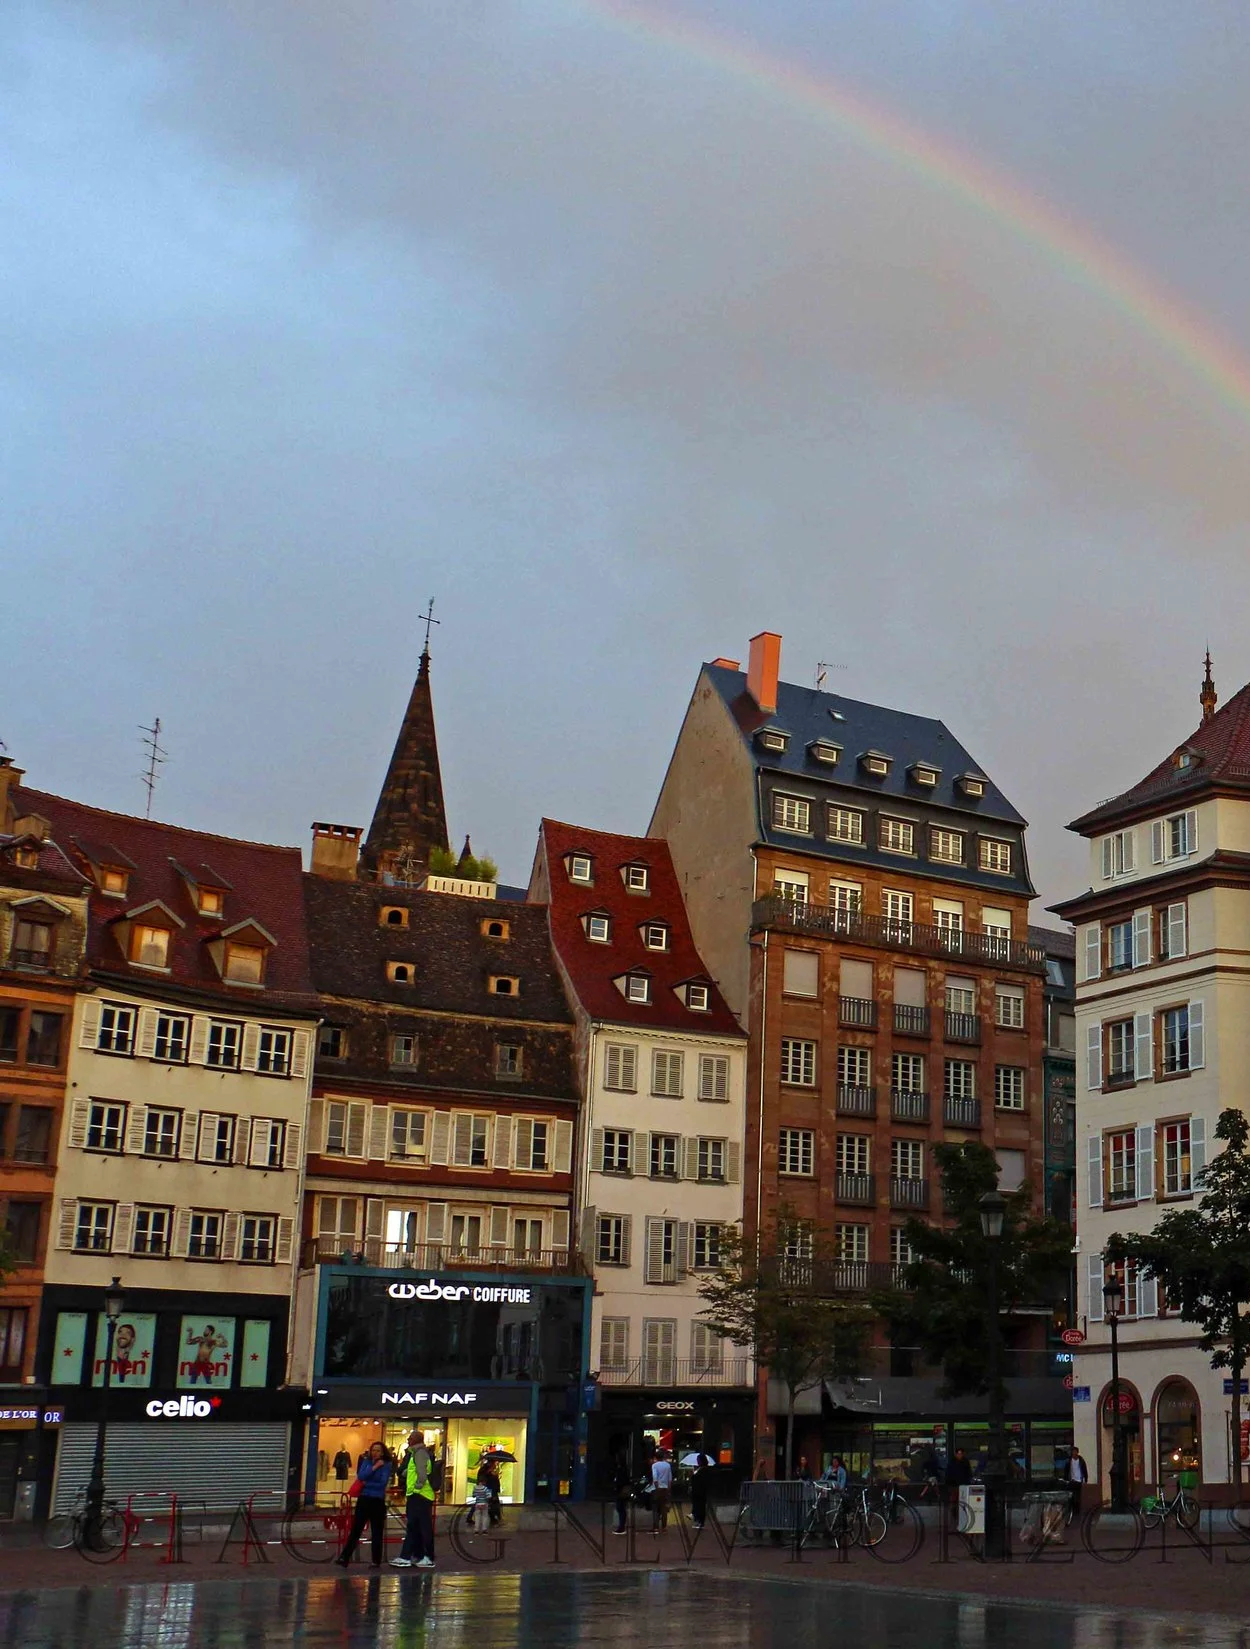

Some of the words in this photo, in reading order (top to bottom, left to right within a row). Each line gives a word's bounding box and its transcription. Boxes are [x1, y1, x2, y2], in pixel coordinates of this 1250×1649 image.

[388, 1279, 470, 1302] weber
[473, 1286, 531, 1304] COIFFURE
[94, 1358, 146, 1375] men
[179, 1359, 228, 1377] men
[381, 1392, 428, 1405] NAF
[431, 1392, 477, 1405] NAF
[656, 1401, 694, 1411] GEOX
[12, 1410, 38, 1419] L'OR
[44, 1411, 61, 1423] OR
